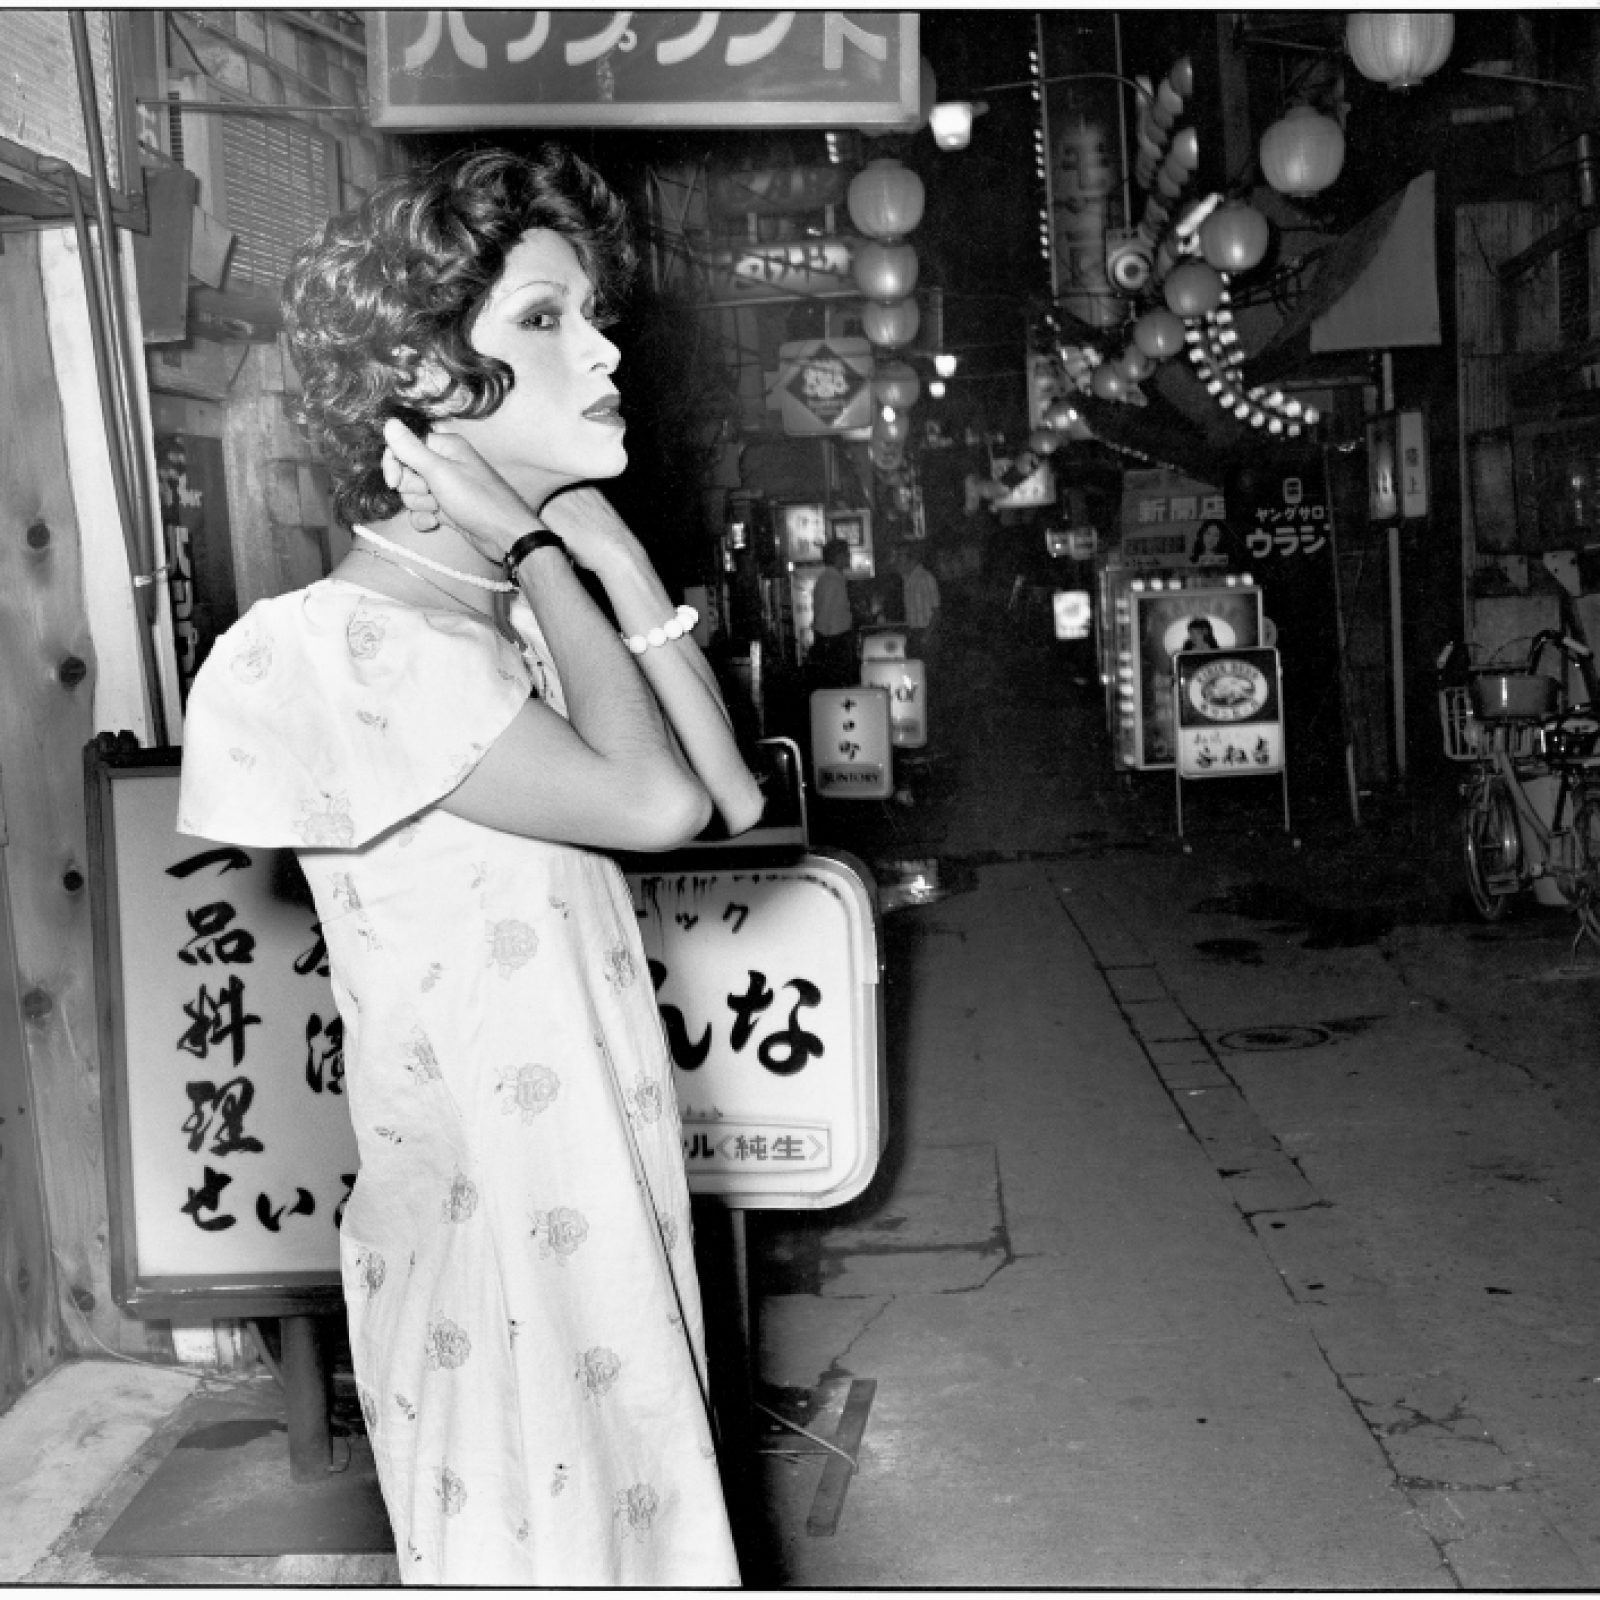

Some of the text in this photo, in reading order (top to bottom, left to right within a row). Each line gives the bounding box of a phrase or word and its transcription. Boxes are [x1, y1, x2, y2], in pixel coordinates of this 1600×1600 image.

[1246, 523, 1331, 558] ウラシ
[165, 847, 264, 1156] 一品料理
